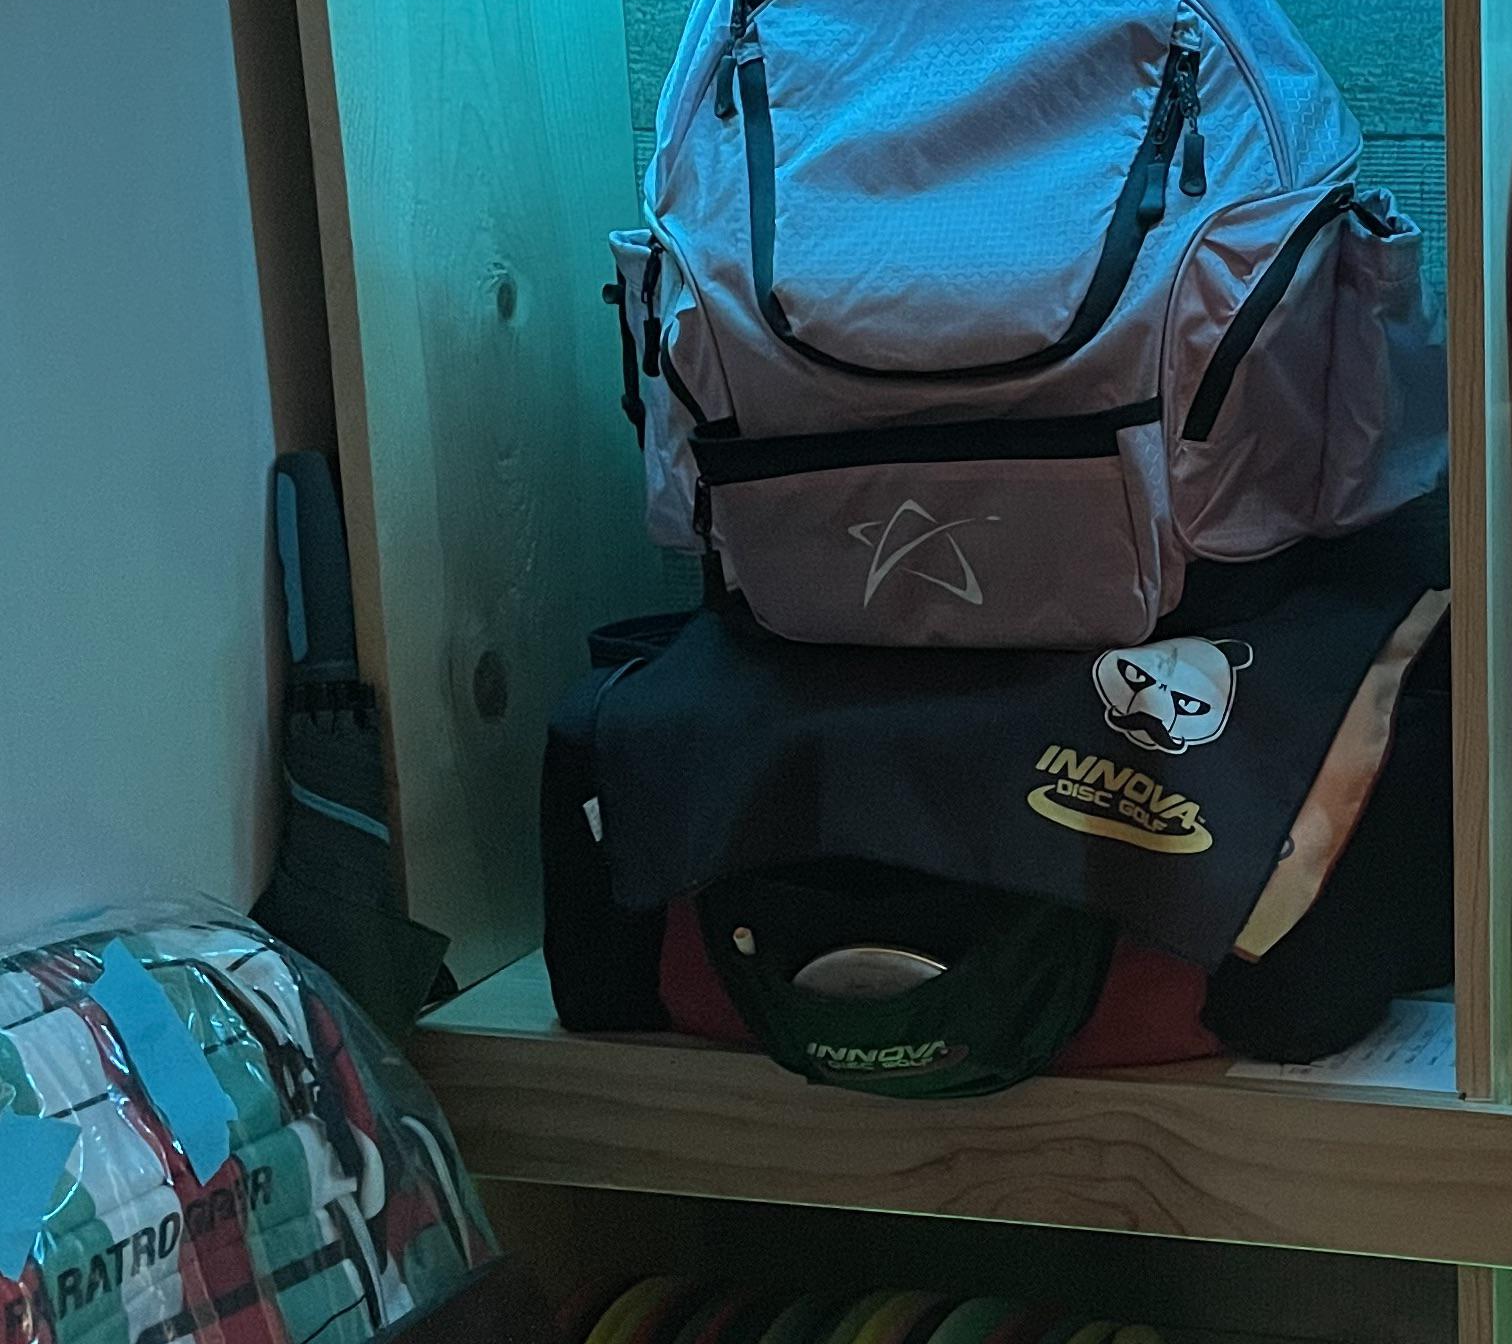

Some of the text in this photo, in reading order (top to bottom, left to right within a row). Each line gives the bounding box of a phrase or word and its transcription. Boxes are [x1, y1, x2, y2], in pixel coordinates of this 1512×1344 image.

[1035, 745, 1200, 830] INNOVA
[1056, 779, 1169, 832] DISC GOLF
[806, 1040, 950, 1063] INNOVA
